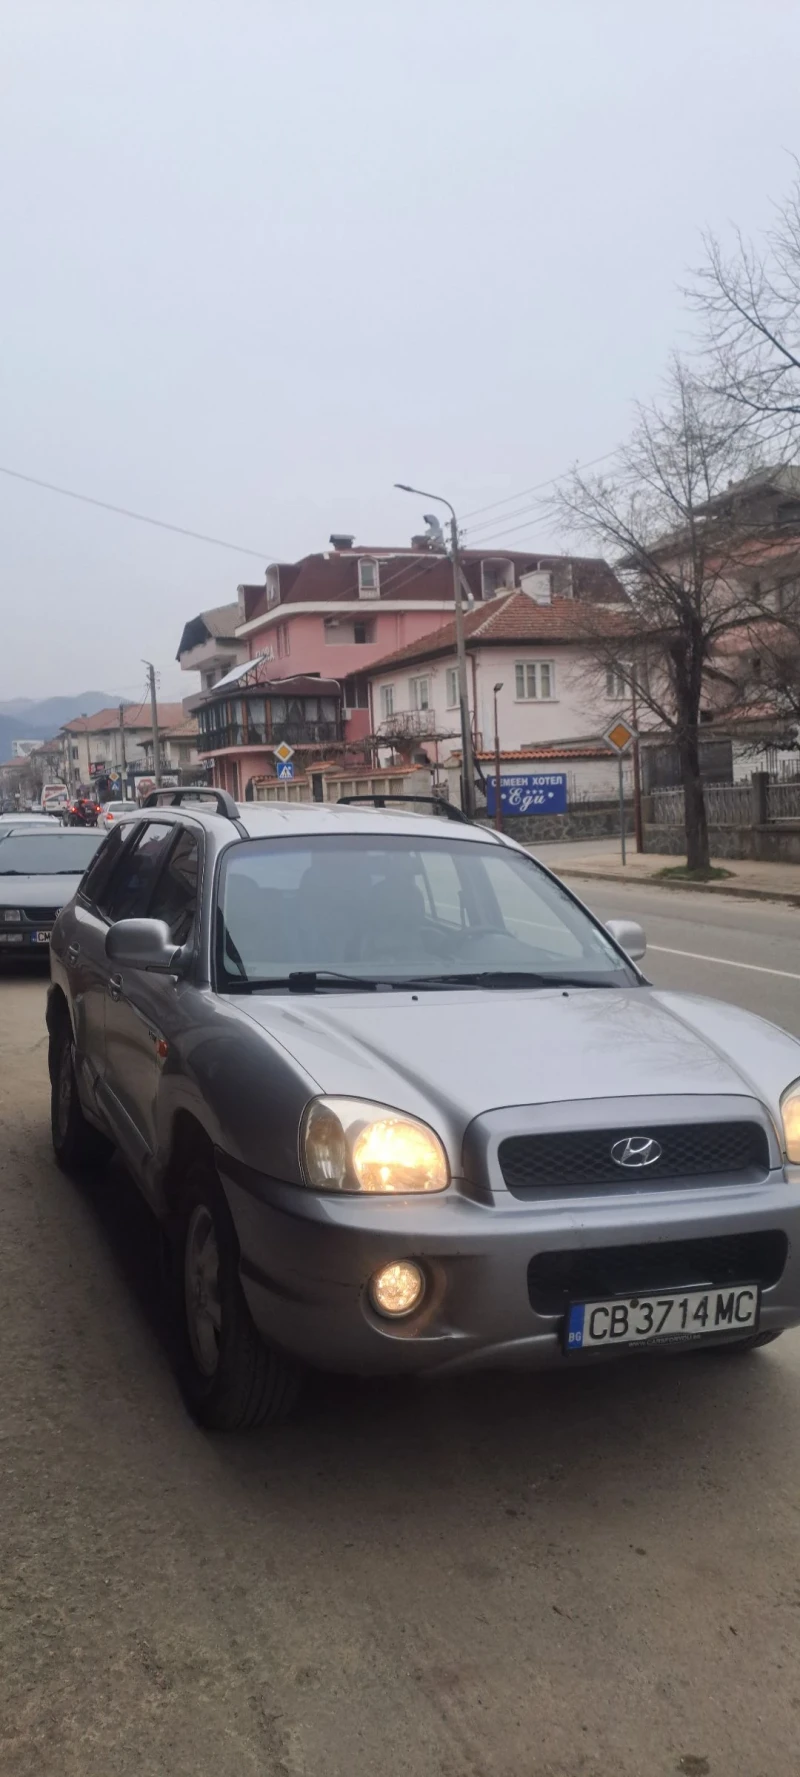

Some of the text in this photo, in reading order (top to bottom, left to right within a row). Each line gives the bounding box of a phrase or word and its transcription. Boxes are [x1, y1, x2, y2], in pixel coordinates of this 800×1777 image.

[532, 776, 563, 786] ХОТЕЛ
[588, 1290, 754, 1340] CB 3714 MC
[568, 1331, 582, 1343] BG
